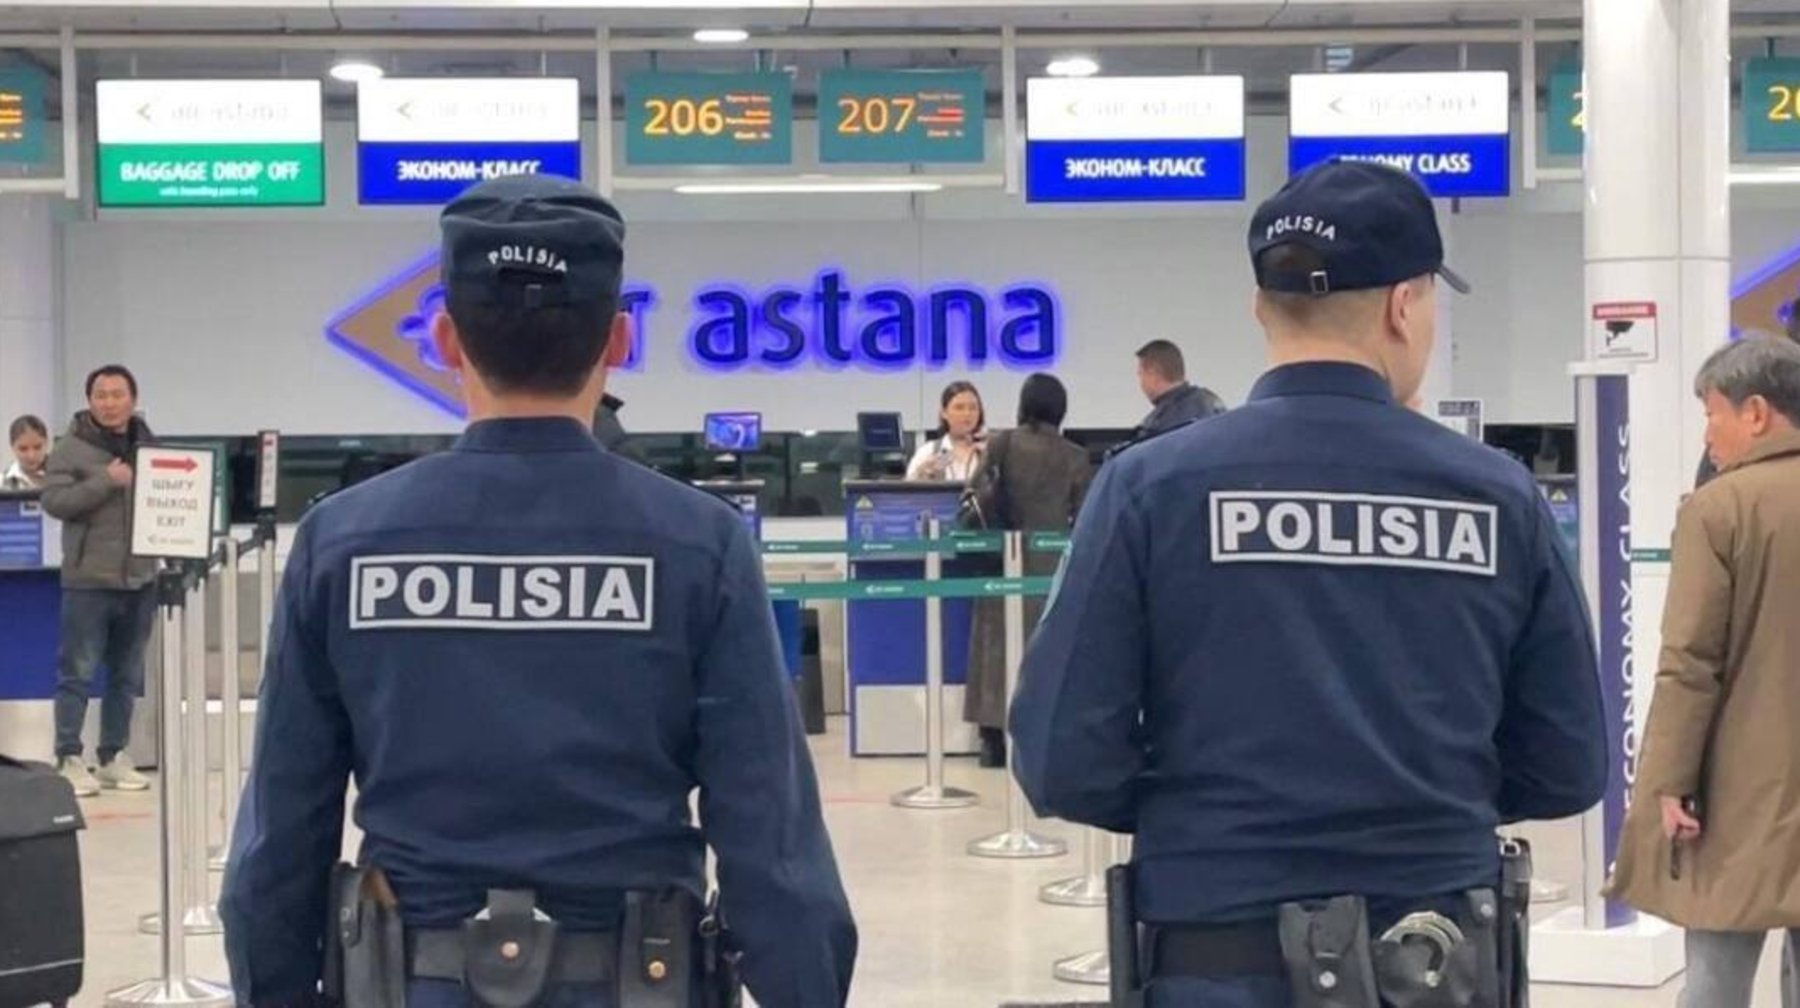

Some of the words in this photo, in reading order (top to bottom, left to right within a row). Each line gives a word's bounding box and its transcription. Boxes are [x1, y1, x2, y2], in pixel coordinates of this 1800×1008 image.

[643, 98, 724, 135] 206
[837, 97, 916, 133] 207
[120, 161, 208, 182] BAGGAGE
[212, 160, 263, 181] DROP
[267, 160, 301, 181] OFF
[396, 160, 541, 180] ЭКОНОМ-КЛАСС
[1064, 158, 1206, 179] ЭКОНОМ-КЛАСС
[1417, 152, 1472, 174] CLASS
[487, 244, 568, 272] POLISIA
[694, 271, 1056, 364] astana
[1221, 501, 1487, 564] POLISIA
[360, 565, 640, 619] POLISIA
